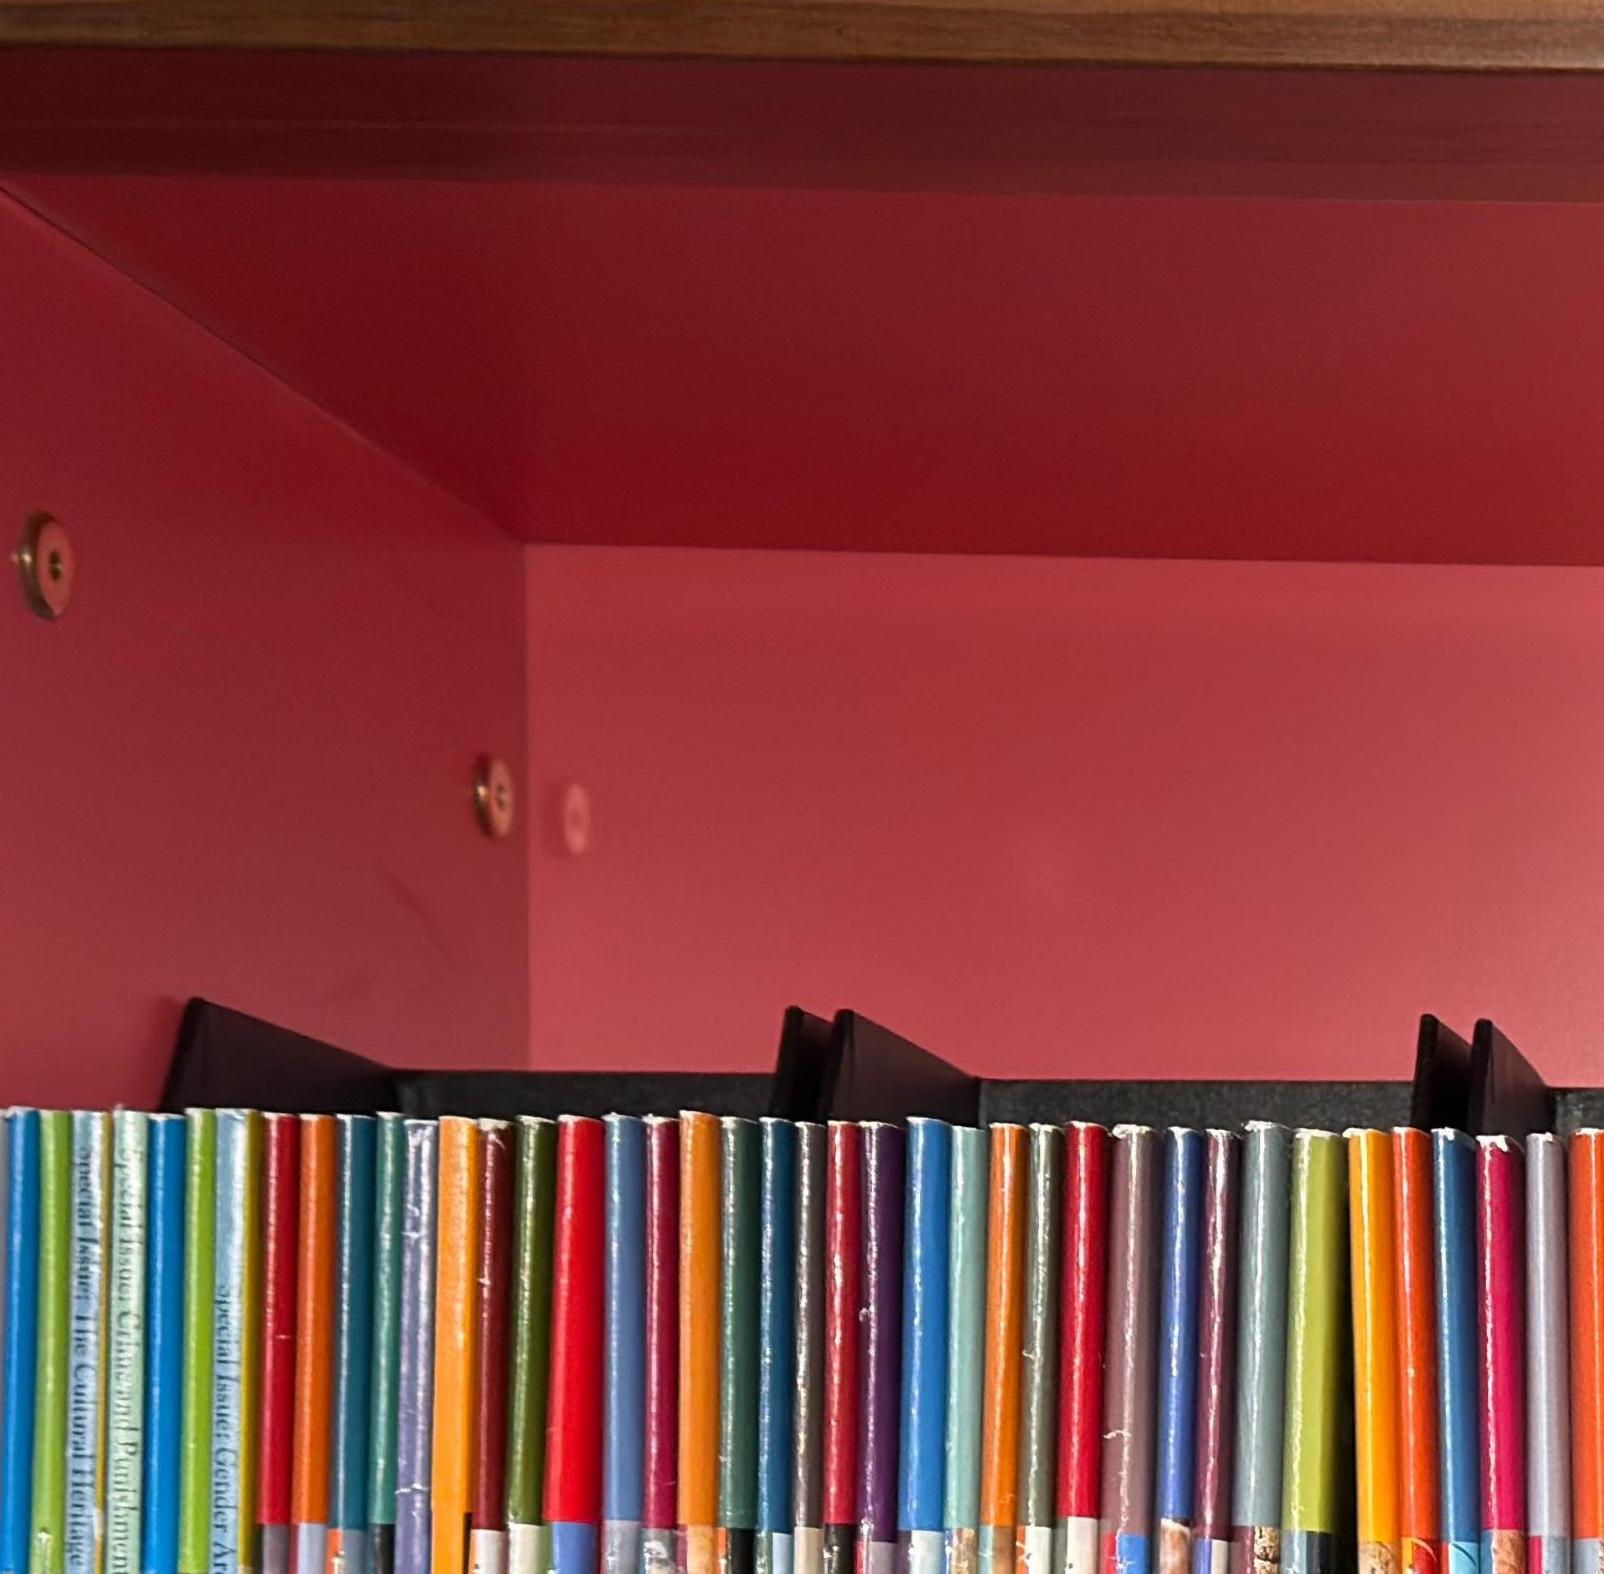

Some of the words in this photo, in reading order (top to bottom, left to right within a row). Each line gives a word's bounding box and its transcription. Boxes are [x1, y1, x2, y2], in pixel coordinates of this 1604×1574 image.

[75, 1314, 98, 1357] The
[115, 1311, 141, 1381] Crime
[214, 1284, 240, 1364] Special
[71, 1363, 97, 1464] Cultural
[115, 1390, 139, 1431] and
[65, 1468, 95, 1566] Heritage
[214, 1447, 237, 1533] Gender
